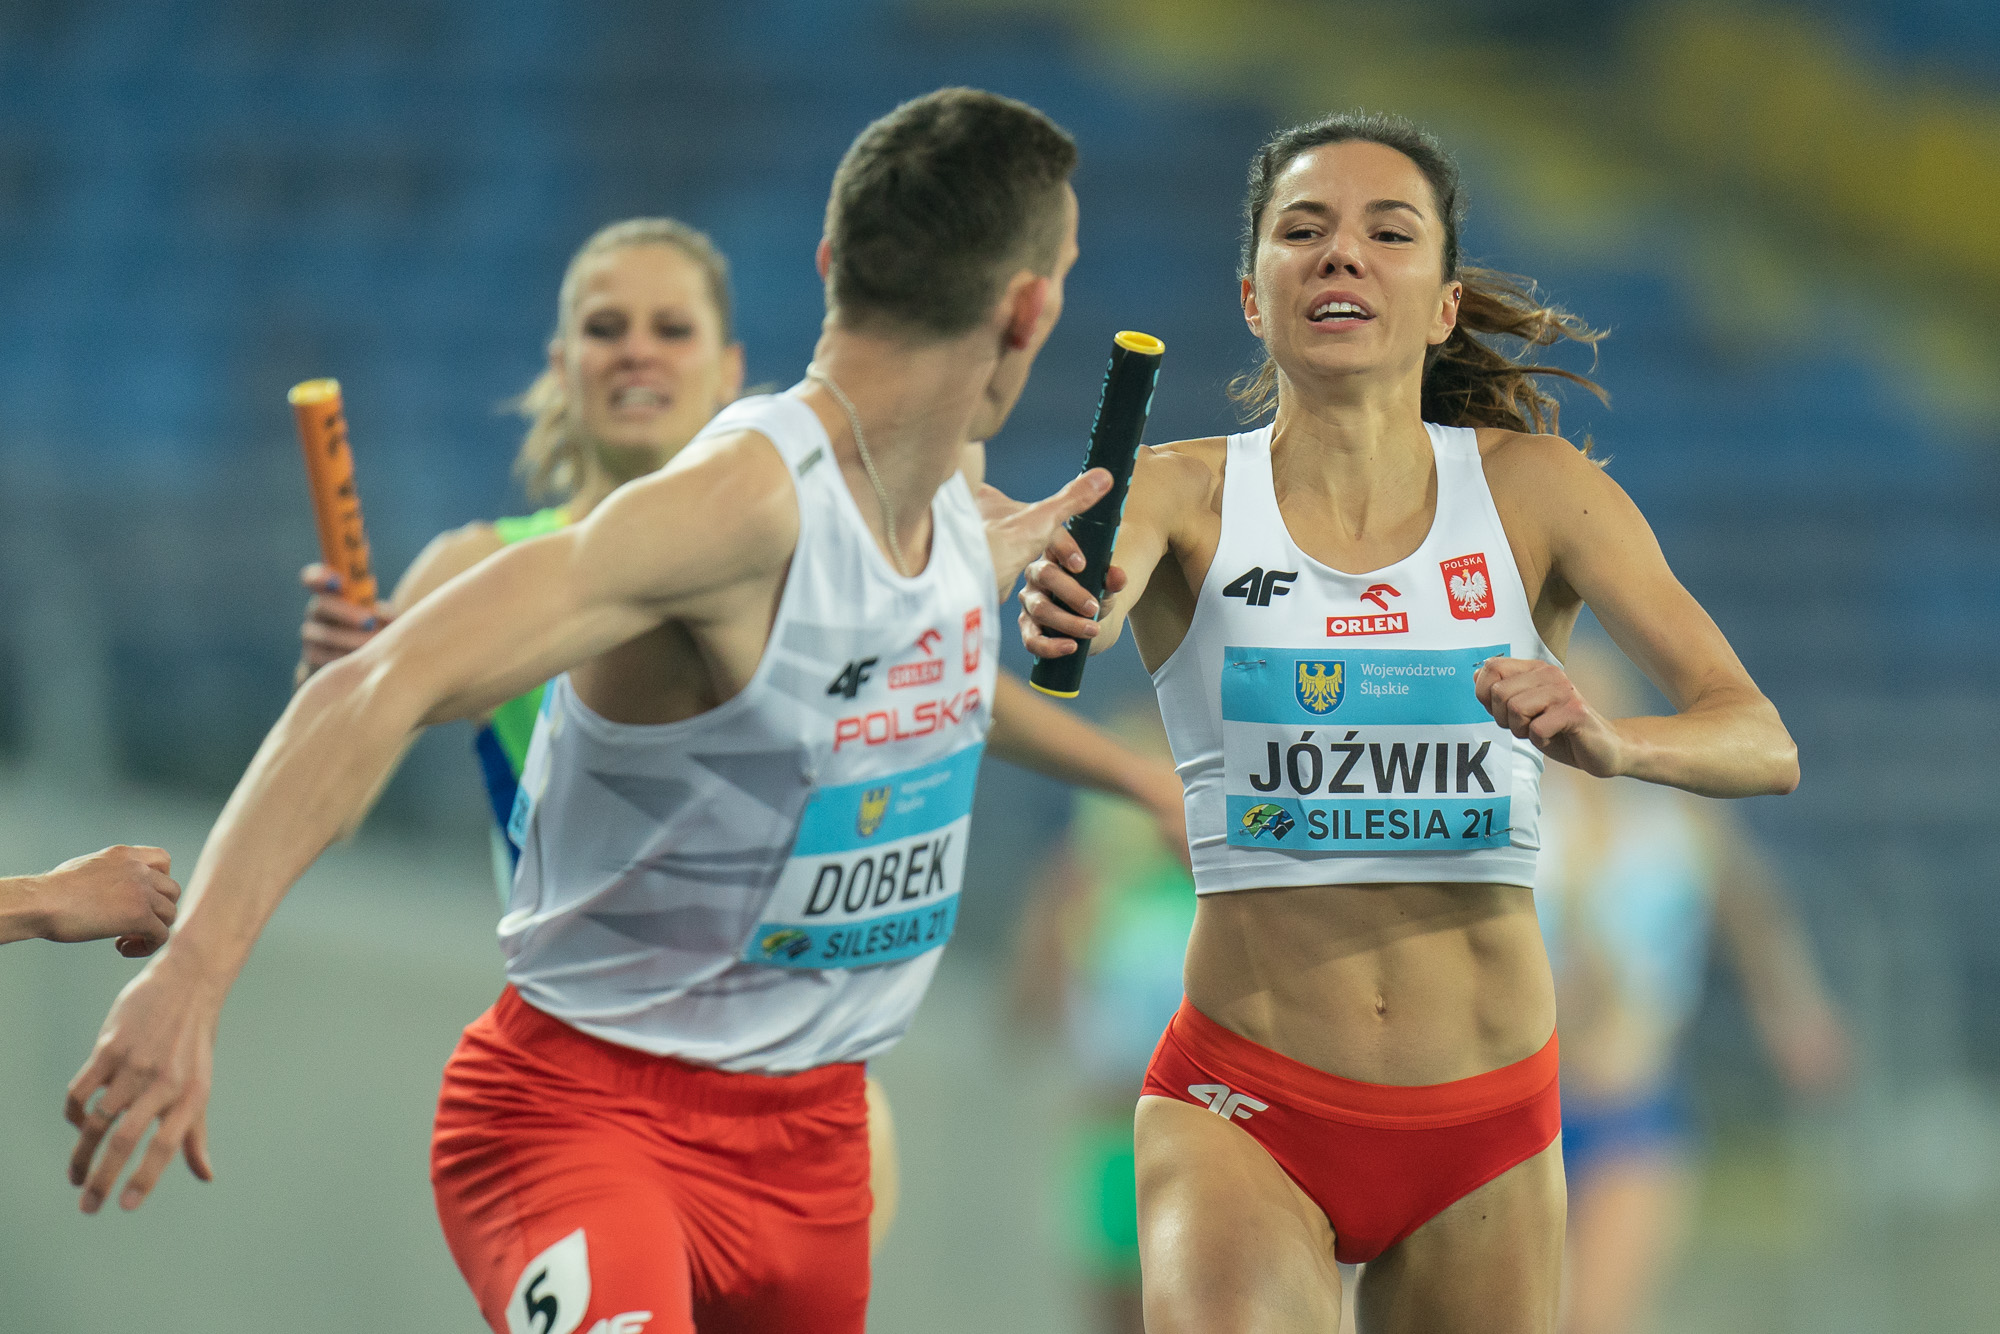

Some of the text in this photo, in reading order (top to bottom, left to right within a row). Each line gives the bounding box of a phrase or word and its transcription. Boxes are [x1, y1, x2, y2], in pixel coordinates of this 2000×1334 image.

[1444, 556, 1483, 570] POLSKA
[1222, 566, 1298, 606] 4F
[1331, 616, 1403, 633] ORLEN
[826, 657, 879, 699] 4F
[1360, 663, 1456, 677] Województwo
[1360, 681, 1409, 698] Śląskie
[1249, 731, 1495, 795] JÓŹWIK
[1308, 808, 1493, 840] SILESIA 21
[804, 835, 951, 917] DOBEK
[823, 918, 918, 959] SILESIA
[1187, 1084, 1269, 1120] 4F
[524, 1267, 558, 1334] 5
